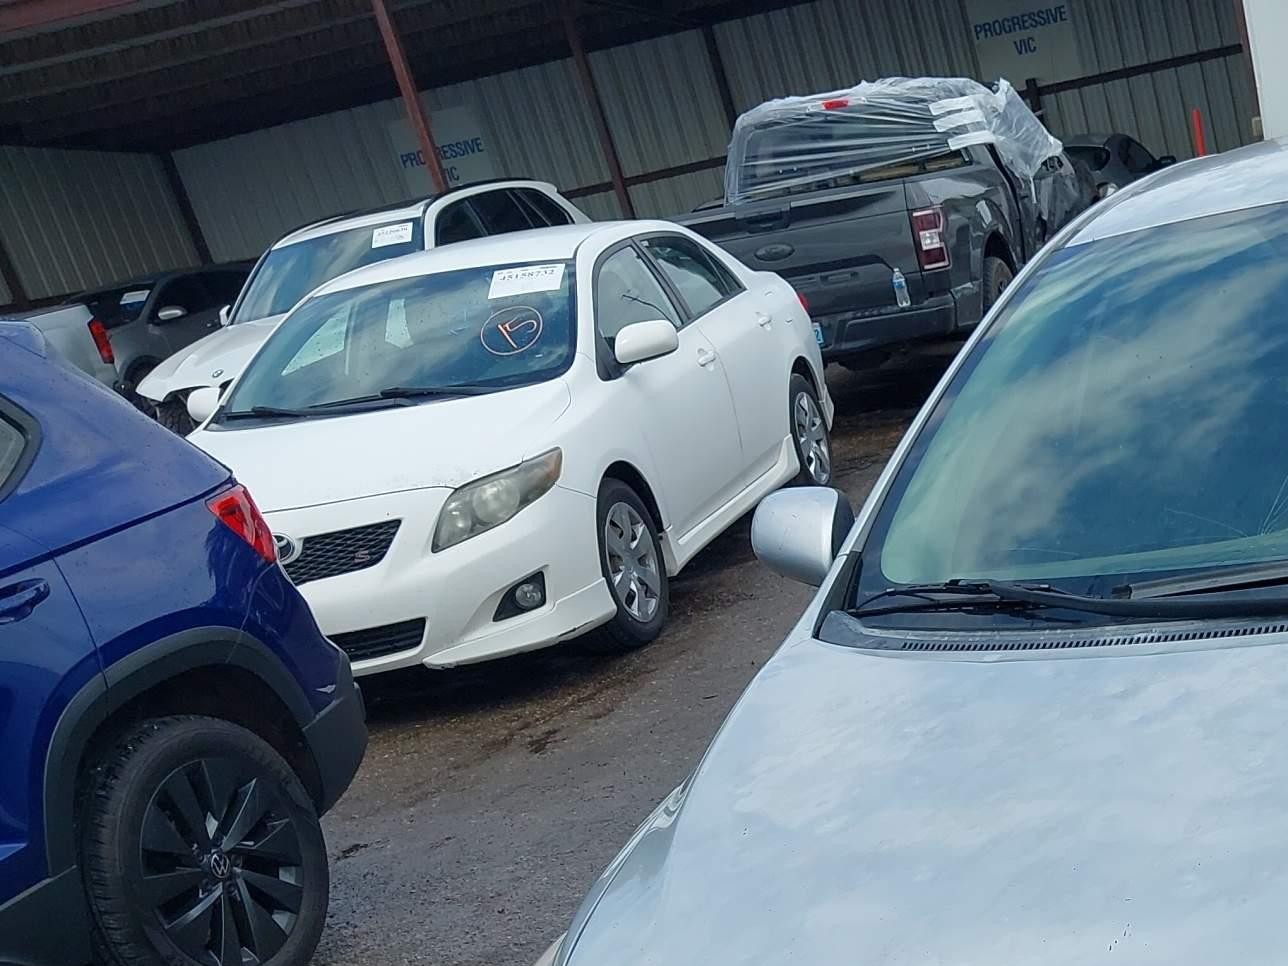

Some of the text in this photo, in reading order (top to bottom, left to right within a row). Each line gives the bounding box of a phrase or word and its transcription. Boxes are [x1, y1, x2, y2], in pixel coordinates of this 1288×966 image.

[974, 5, 1067, 40] PROGRESSIVE
[1013, 37, 1037, 55] VIC
[400, 137, 484, 168] PRORESSIVE
